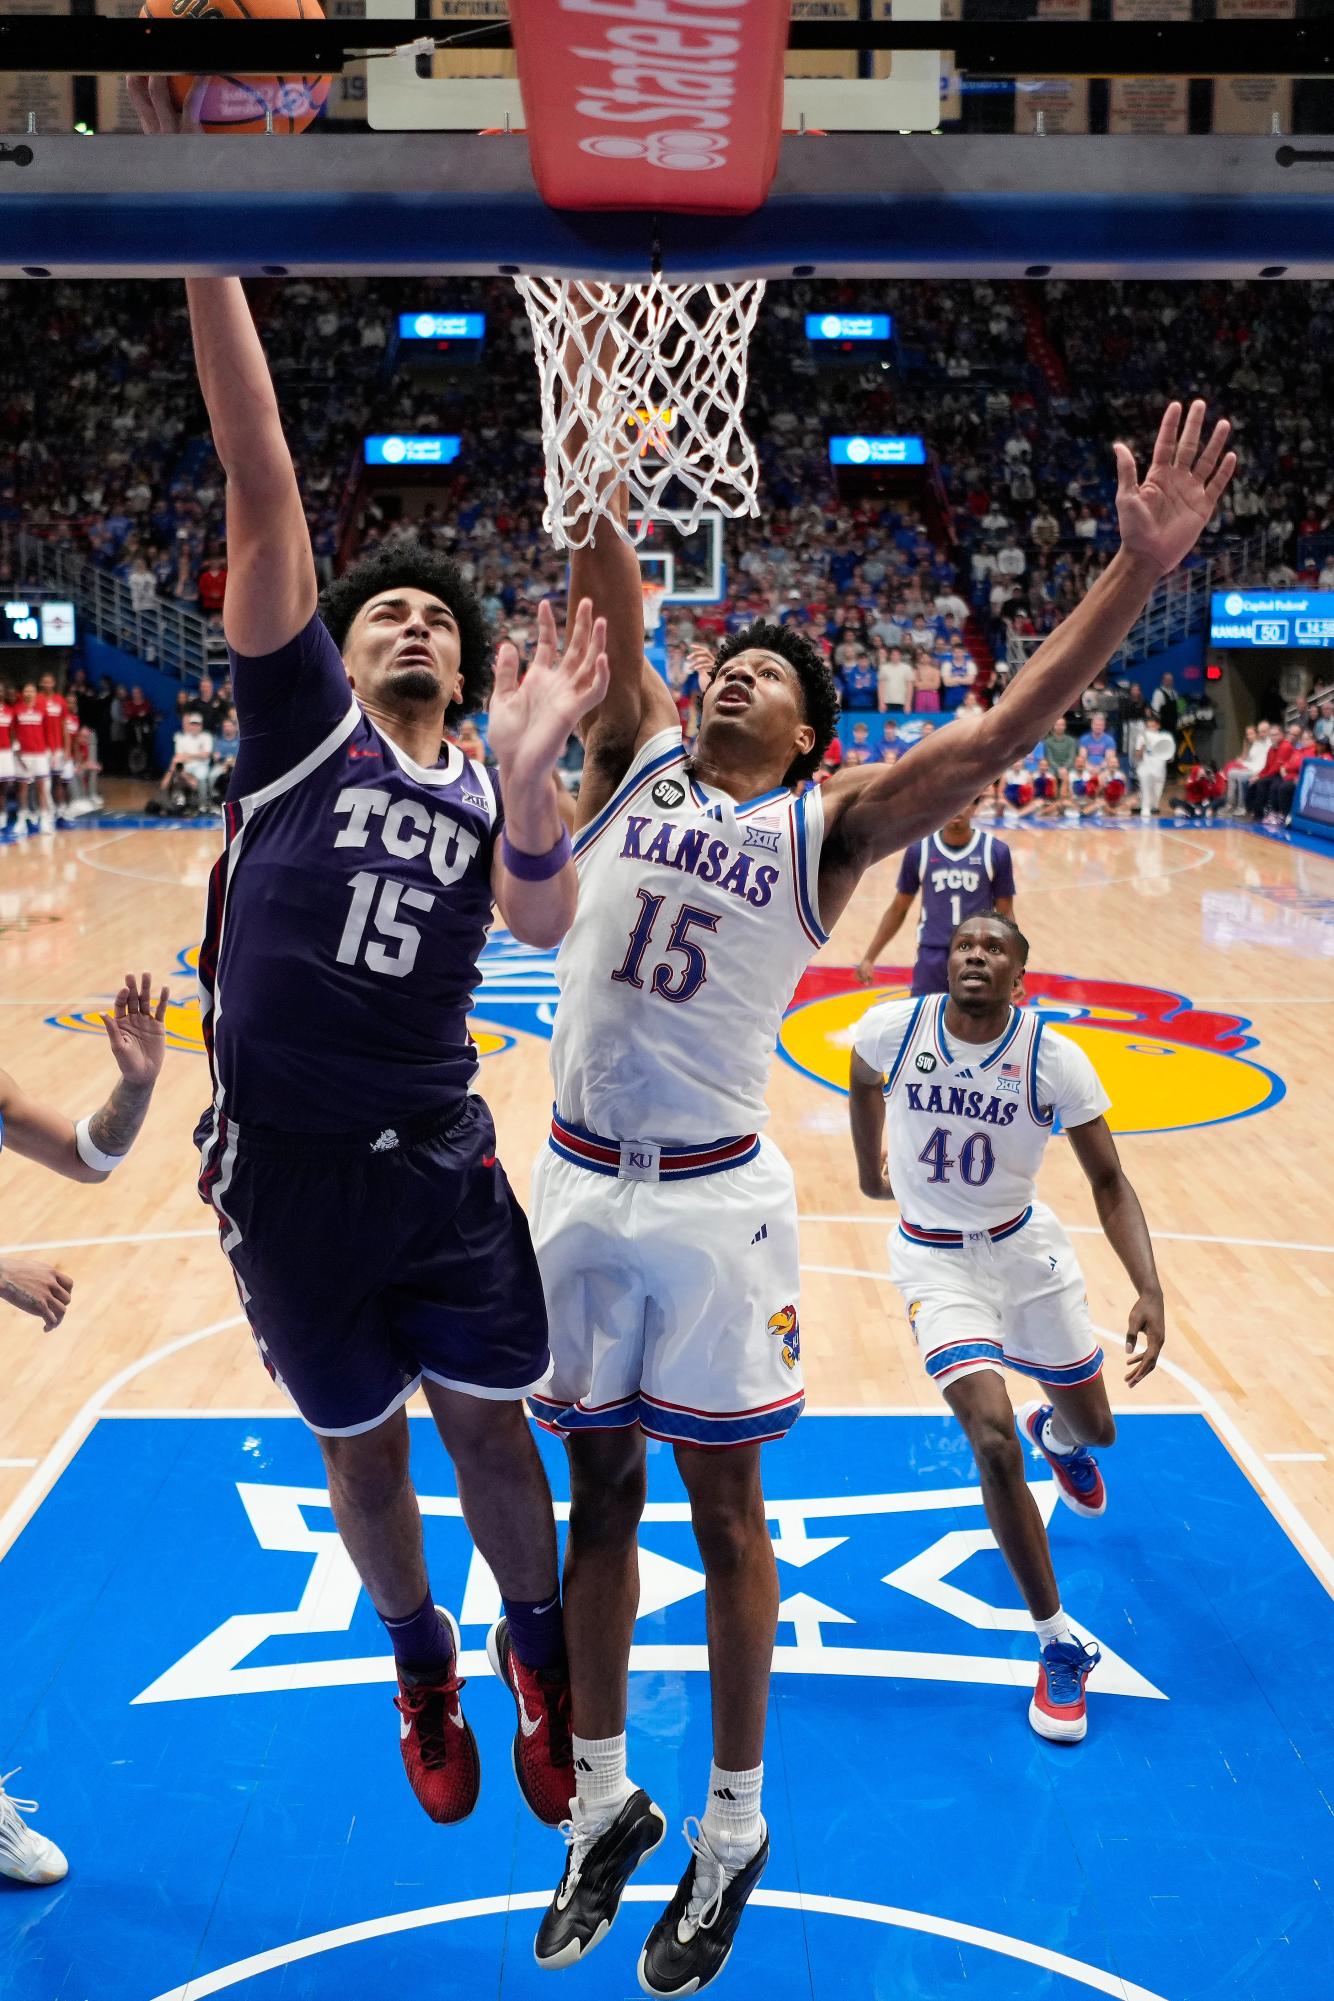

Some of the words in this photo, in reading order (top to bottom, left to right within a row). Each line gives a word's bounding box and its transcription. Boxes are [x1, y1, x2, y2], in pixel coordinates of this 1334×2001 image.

[567, 25, 741, 129] State
[1261, 624, 1280, 640] 50
[654, 781, 683, 806] SW
[333, 788, 480, 886] TCU
[619, 815, 779, 907] KANSAS
[931, 868, 980, 893] TCU
[335, 871, 436, 978] 15
[950, 895, 960, 926] 1
[611, 887, 723, 1003] 15
[916, 1055, 934, 1071] SW
[905, 1083, 1019, 1127] KANSAS
[628, 1151, 653, 1169] KU
[918, 1126, 996, 1187] 40
